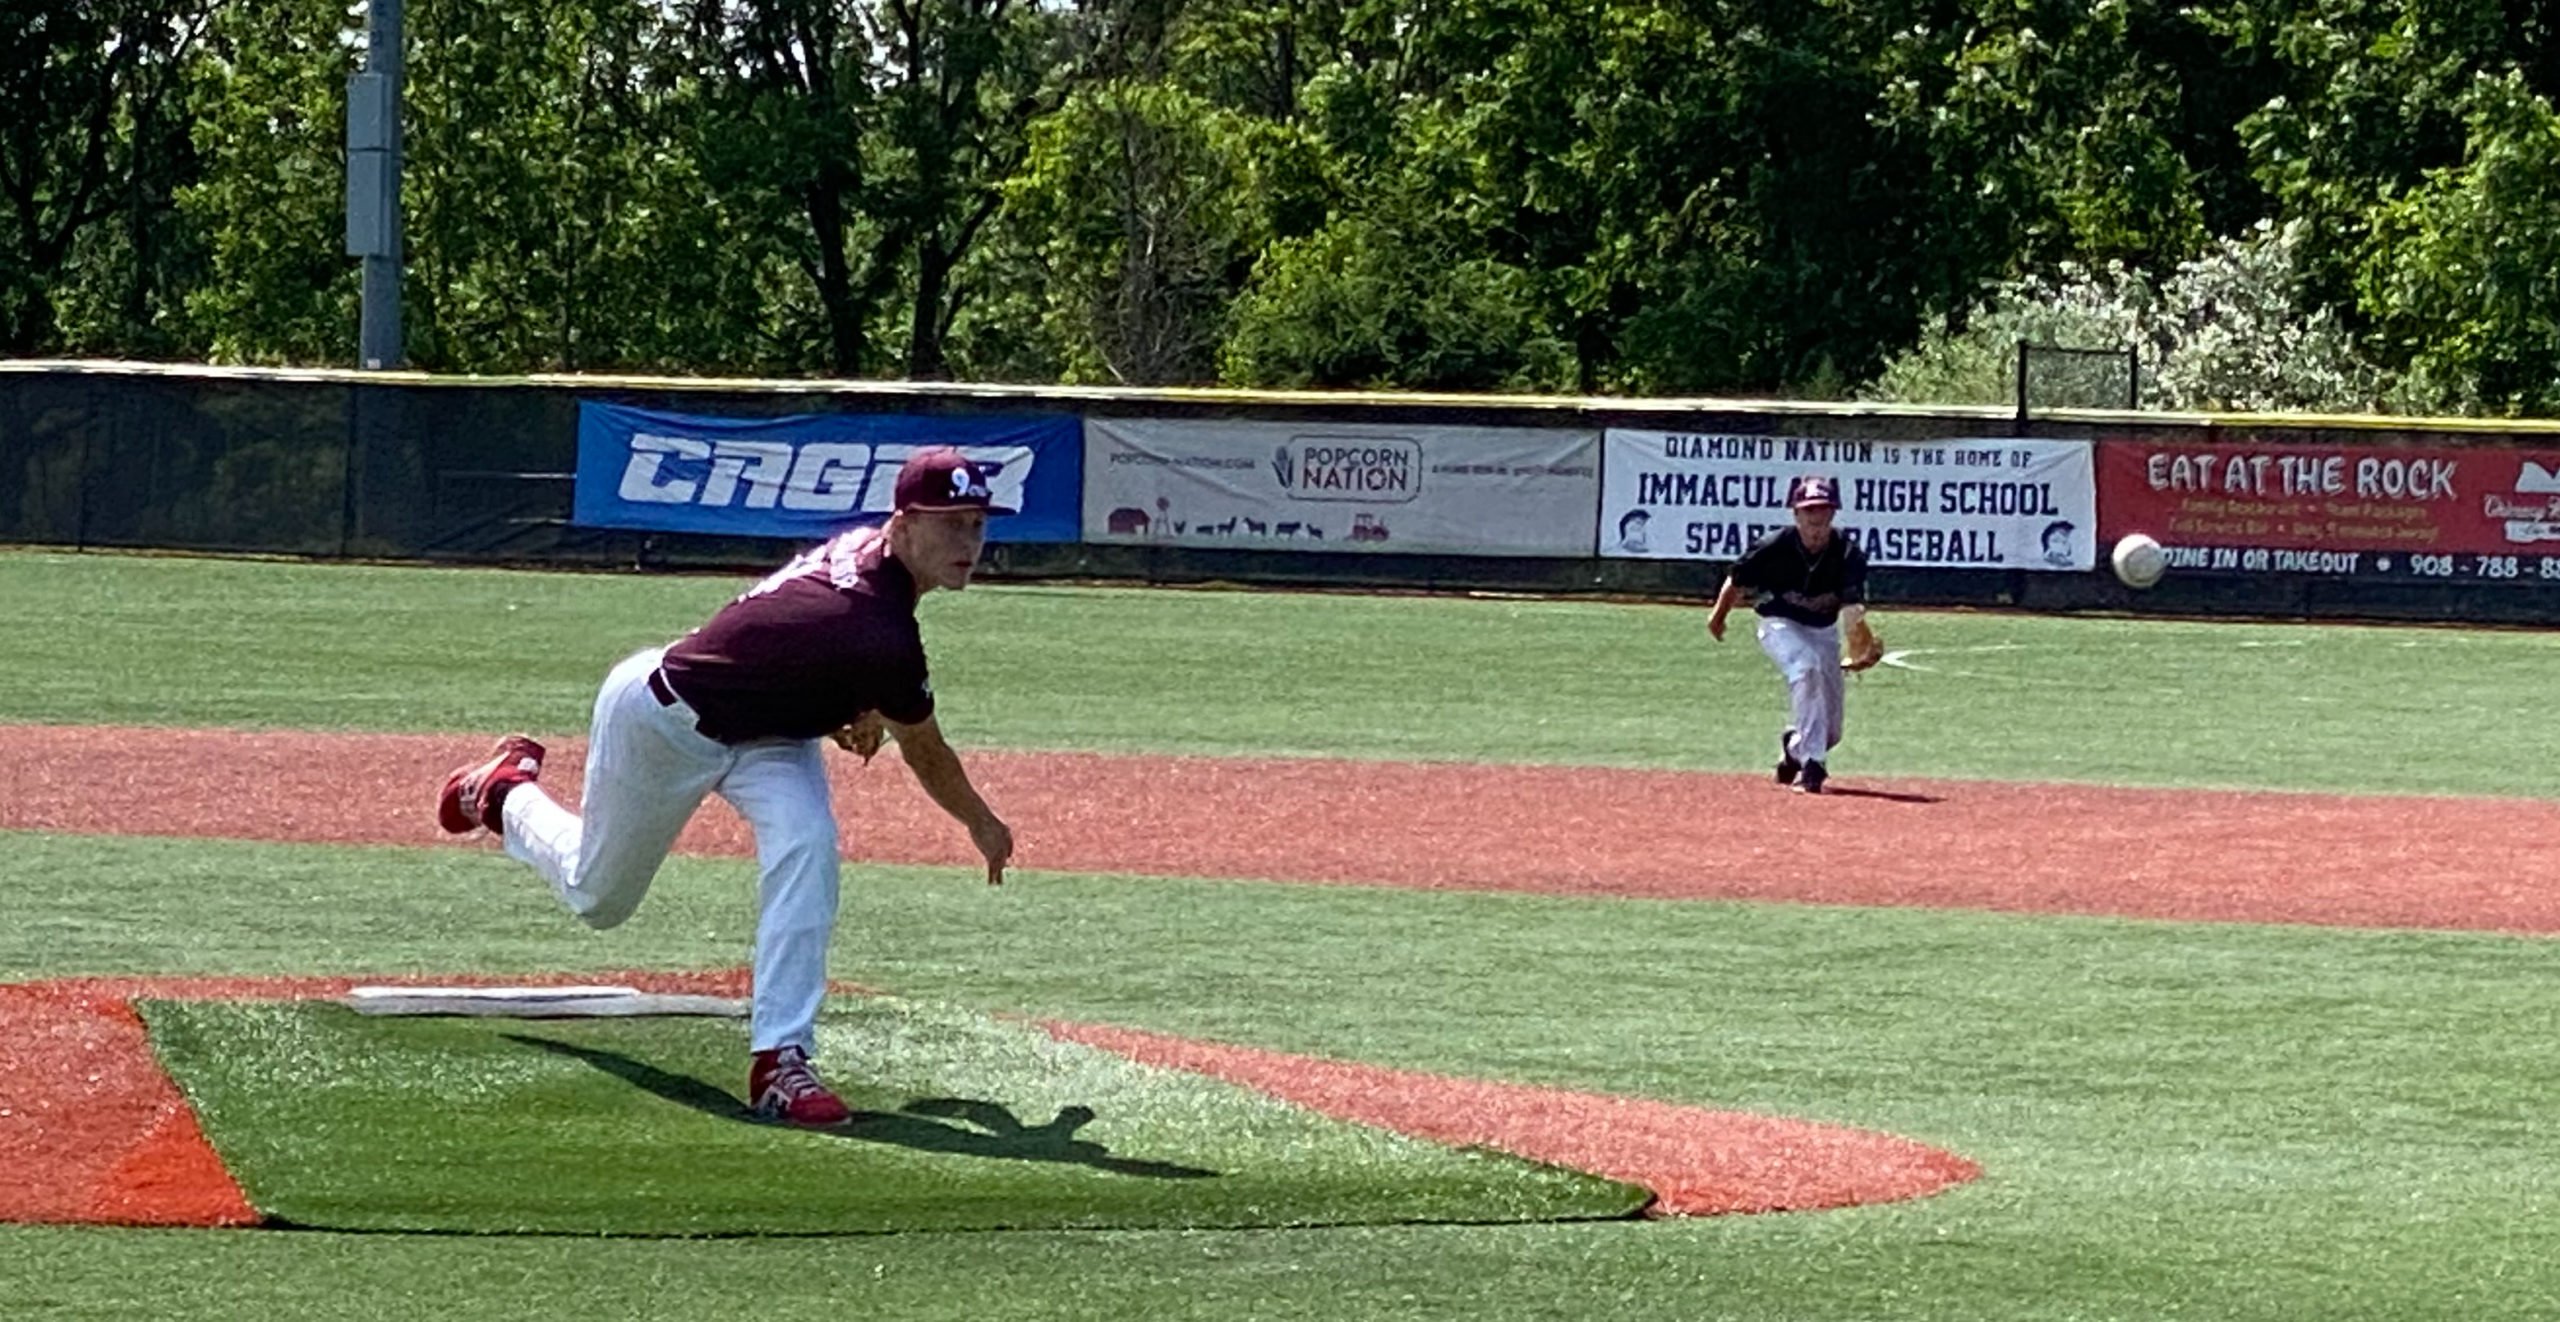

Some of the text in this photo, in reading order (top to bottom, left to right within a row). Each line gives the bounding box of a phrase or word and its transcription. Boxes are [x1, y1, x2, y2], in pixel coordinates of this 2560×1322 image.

[1304, 447, 1408, 466] POPCORN
[1665, 436, 2032, 468] DIAMOND NATION IS THE HOME OF
[1302, 467, 1406, 490] NATION
[2148, 453, 2457, 500] EAT AT THE ROCK
[1638, 473, 2059, 516] IMMACUL HIGH SCHOOL
[1686, 522, 1786, 554] SPAR
[2160, 547, 2360, 573] DINE IN OR TAKEOUT
[2410, 553, 2453, 576] 908
[2476, 556, 2518, 578] 788
